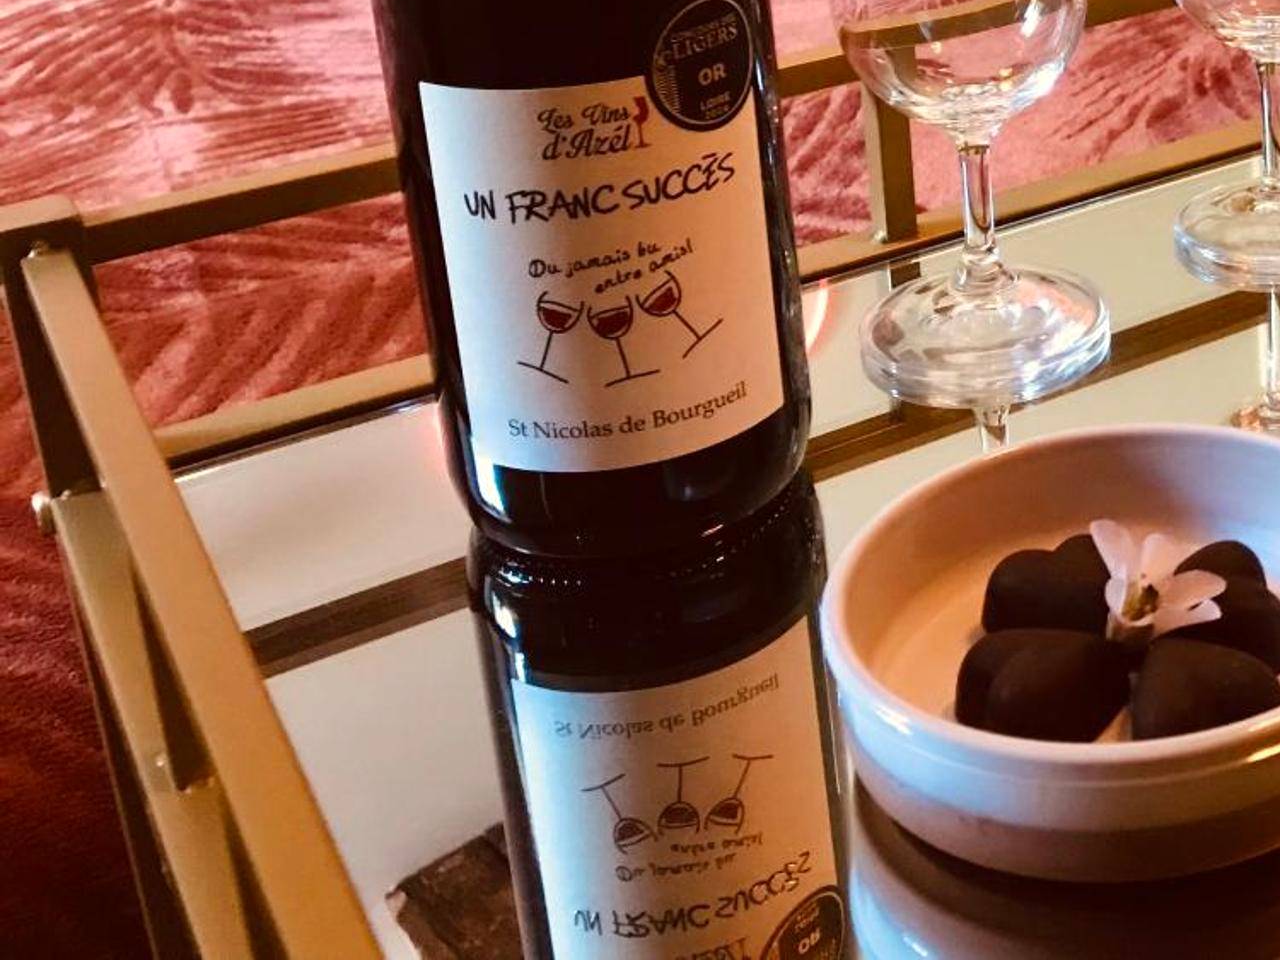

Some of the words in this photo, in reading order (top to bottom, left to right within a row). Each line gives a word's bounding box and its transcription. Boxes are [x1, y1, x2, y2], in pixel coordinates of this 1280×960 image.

[698, 63, 727, 86] OR
[537, 104, 574, 132] Les
[584, 103, 630, 126] Vins
[464, 190, 496, 221] UN
[505, 184, 620, 224] FRANC
[529, 259, 561, 278] Du
[565, 249, 631, 278] jamais
[637, 241, 661, 258] bu
[594, 268, 643, 294] entre
[649, 238, 693, 271] amis!
[508, 418, 528, 437] St
[533, 420, 612, 440] Nicolas
[618, 416, 646, 434] de
[653, 380, 748, 428] Bourgueil
